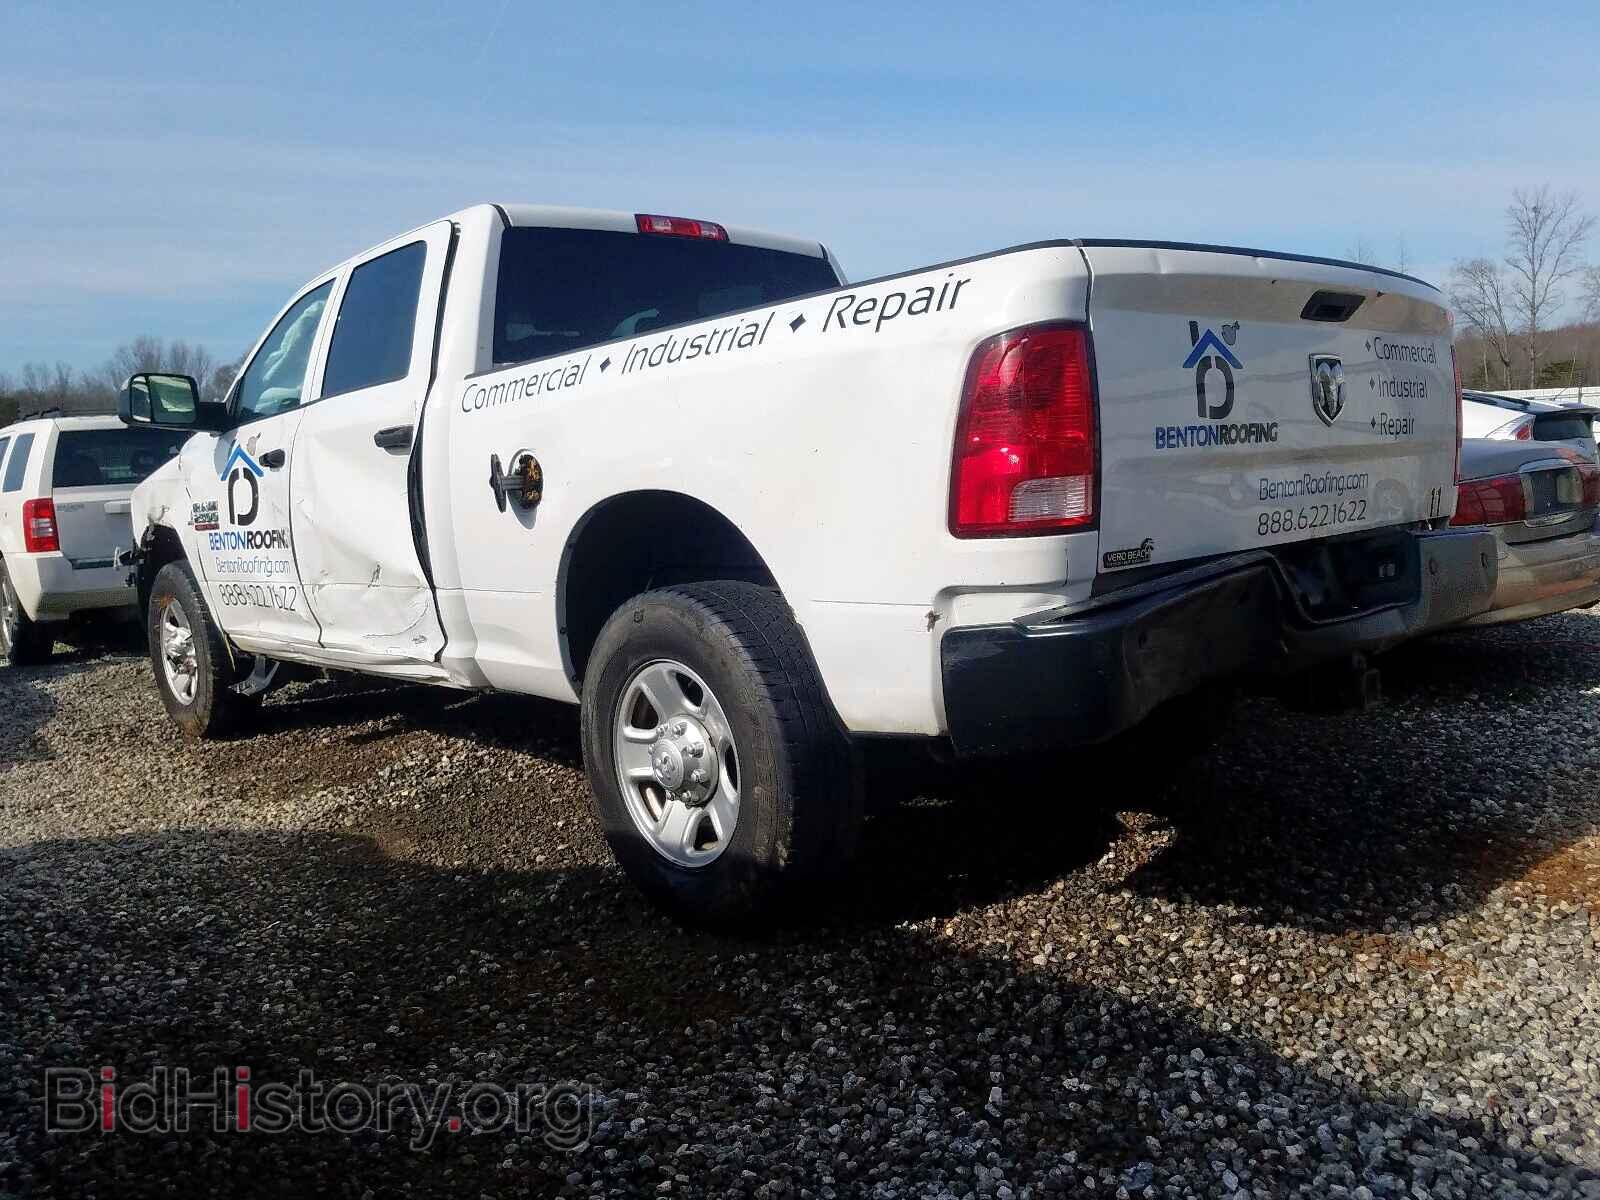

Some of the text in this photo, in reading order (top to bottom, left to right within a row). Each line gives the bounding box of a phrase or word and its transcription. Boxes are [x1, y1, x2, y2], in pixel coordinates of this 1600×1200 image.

[460, 272, 972, 414] Commercial Industrial Repair
[1373, 336, 1437, 364] Commercial
[1378, 376, 1428, 398] Industrial
[1155, 422, 1278, 449] BENTONROOFING
[1379, 411, 1415, 439] Repair
[1259, 472, 1369, 500] BentonRoofing.com
[1257, 500, 1368, 536] 888.622.1622
